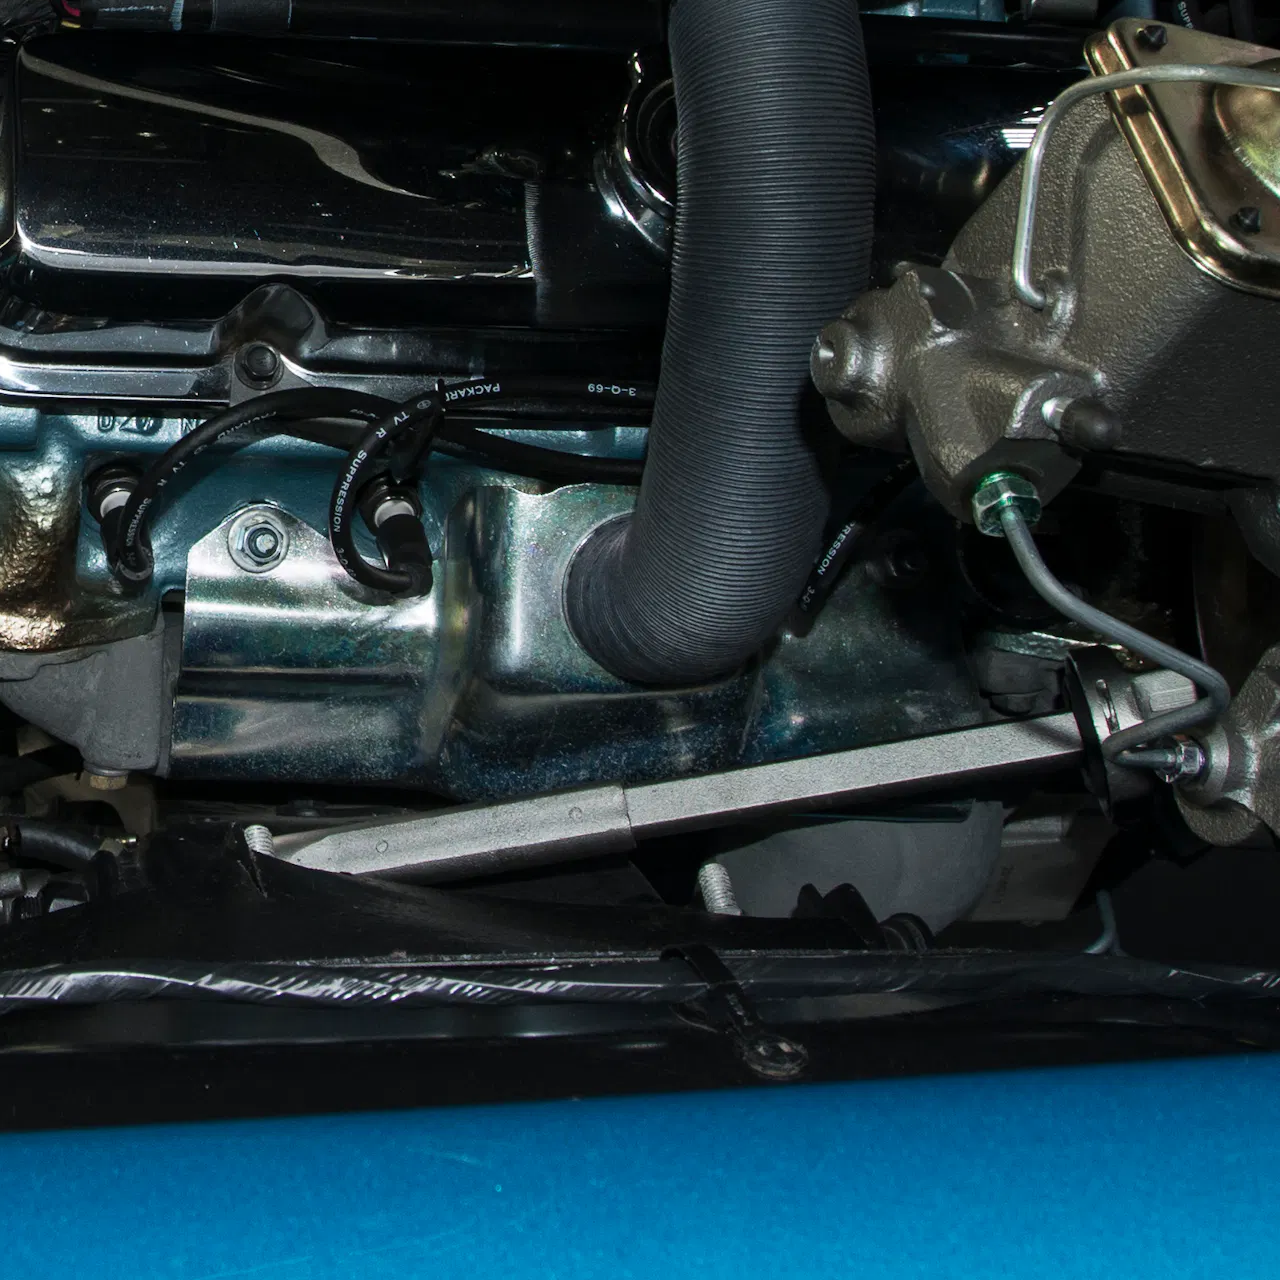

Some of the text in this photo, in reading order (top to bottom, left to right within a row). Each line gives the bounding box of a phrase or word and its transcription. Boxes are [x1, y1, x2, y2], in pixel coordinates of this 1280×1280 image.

[587, 382, 637, 397] 3-Q-69
[393, 411, 410, 427] TV
[375, 427, 388, 439] R
[333, 449, 368, 533] SUPPRESSION
